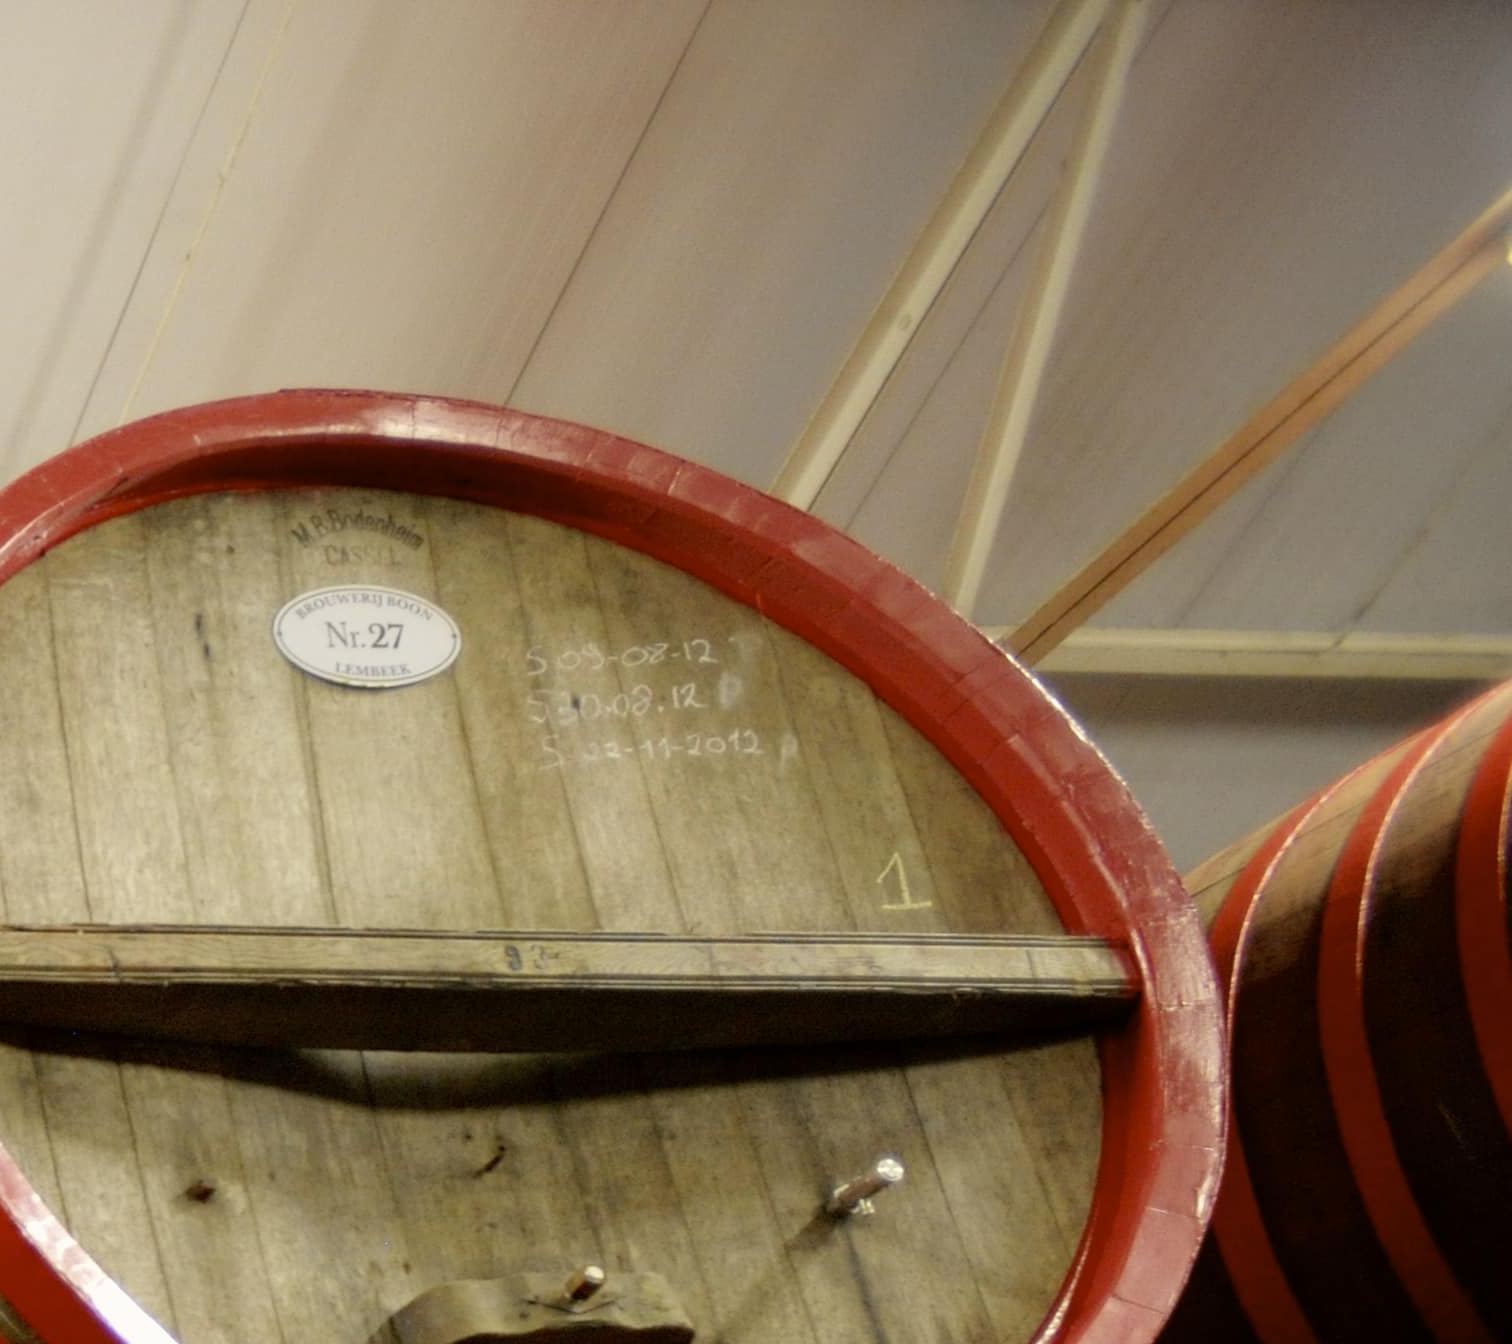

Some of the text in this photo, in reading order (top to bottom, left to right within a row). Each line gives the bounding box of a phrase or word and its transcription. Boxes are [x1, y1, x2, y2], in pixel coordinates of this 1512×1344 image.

[294, 592, 434, 622] BROUWERIJ BOON
[334, 661, 413, 678] LEMBEEK
